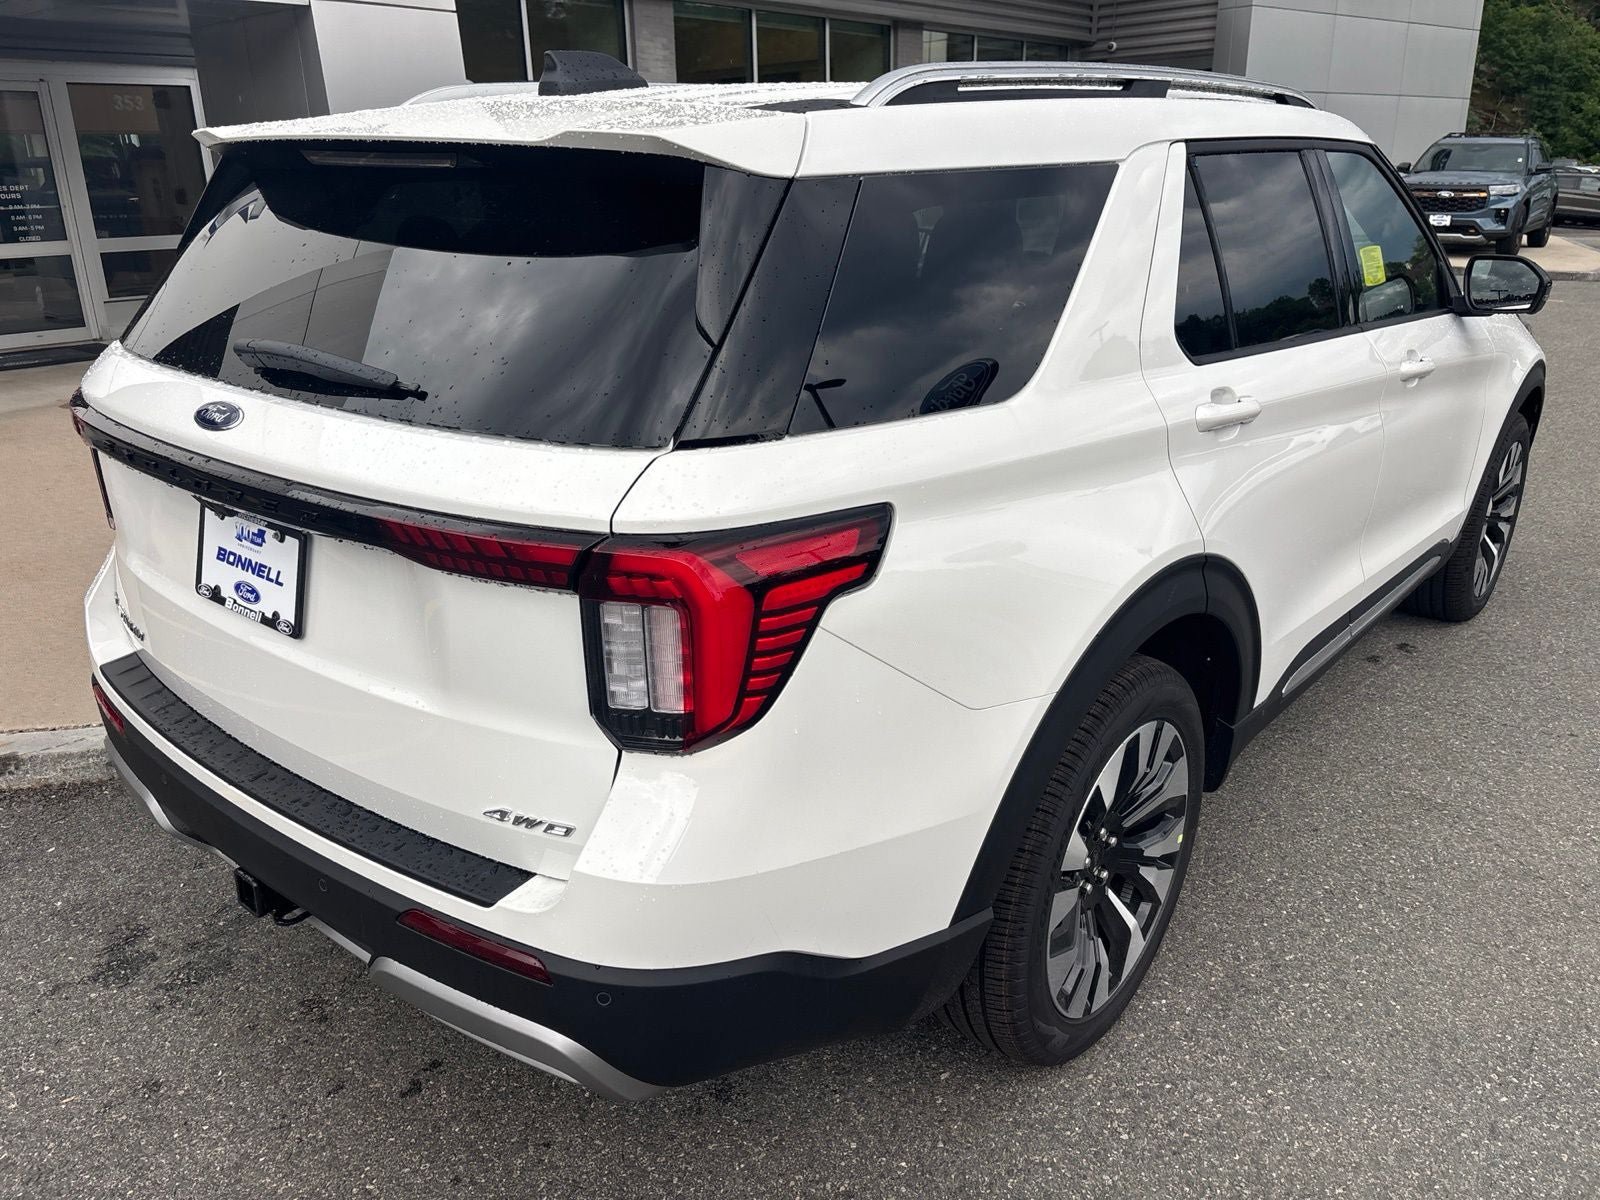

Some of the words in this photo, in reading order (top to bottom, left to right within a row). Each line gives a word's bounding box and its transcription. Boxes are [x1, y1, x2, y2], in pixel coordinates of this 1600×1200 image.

[113, 95, 144, 111] 353
[201, 404, 231, 423] Ford
[235, 521, 252, 543] 100
[216, 546, 284, 587] BONNELL
[237, 582, 257, 603] Ford
[224, 597, 263, 623] Bonnell
[483, 808, 576, 838] 4WD
